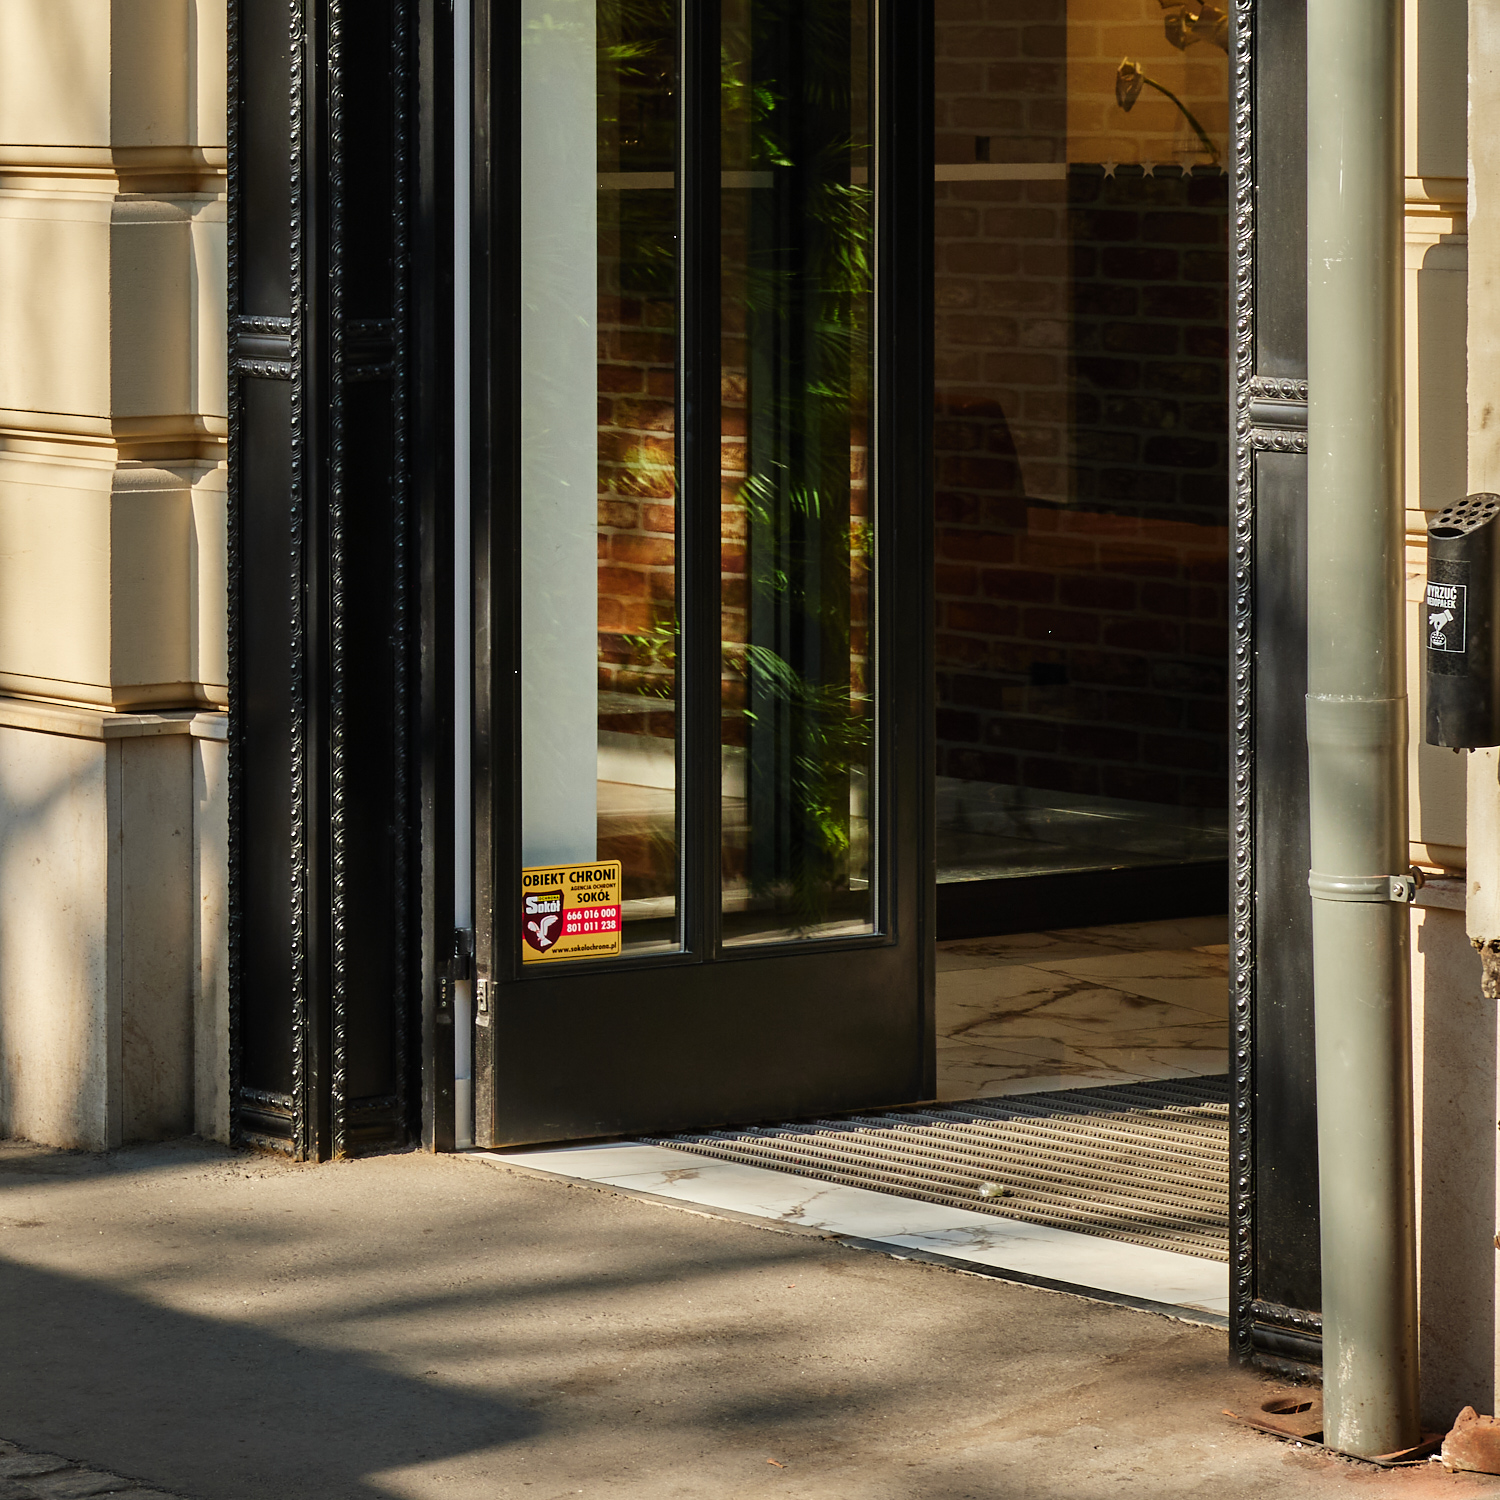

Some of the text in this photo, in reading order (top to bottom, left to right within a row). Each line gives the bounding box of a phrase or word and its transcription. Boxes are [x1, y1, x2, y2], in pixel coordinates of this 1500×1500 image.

[523, 868, 616, 887] OBIEKT CHRONI
[592, 882, 616, 890] OCHRONY
[577, 889, 610, 903] SOKÓŁ
[525, 896, 560, 914] Sokół
[566, 908, 616, 921] 666 016 000
[566, 920, 616, 933] 801 011 238
